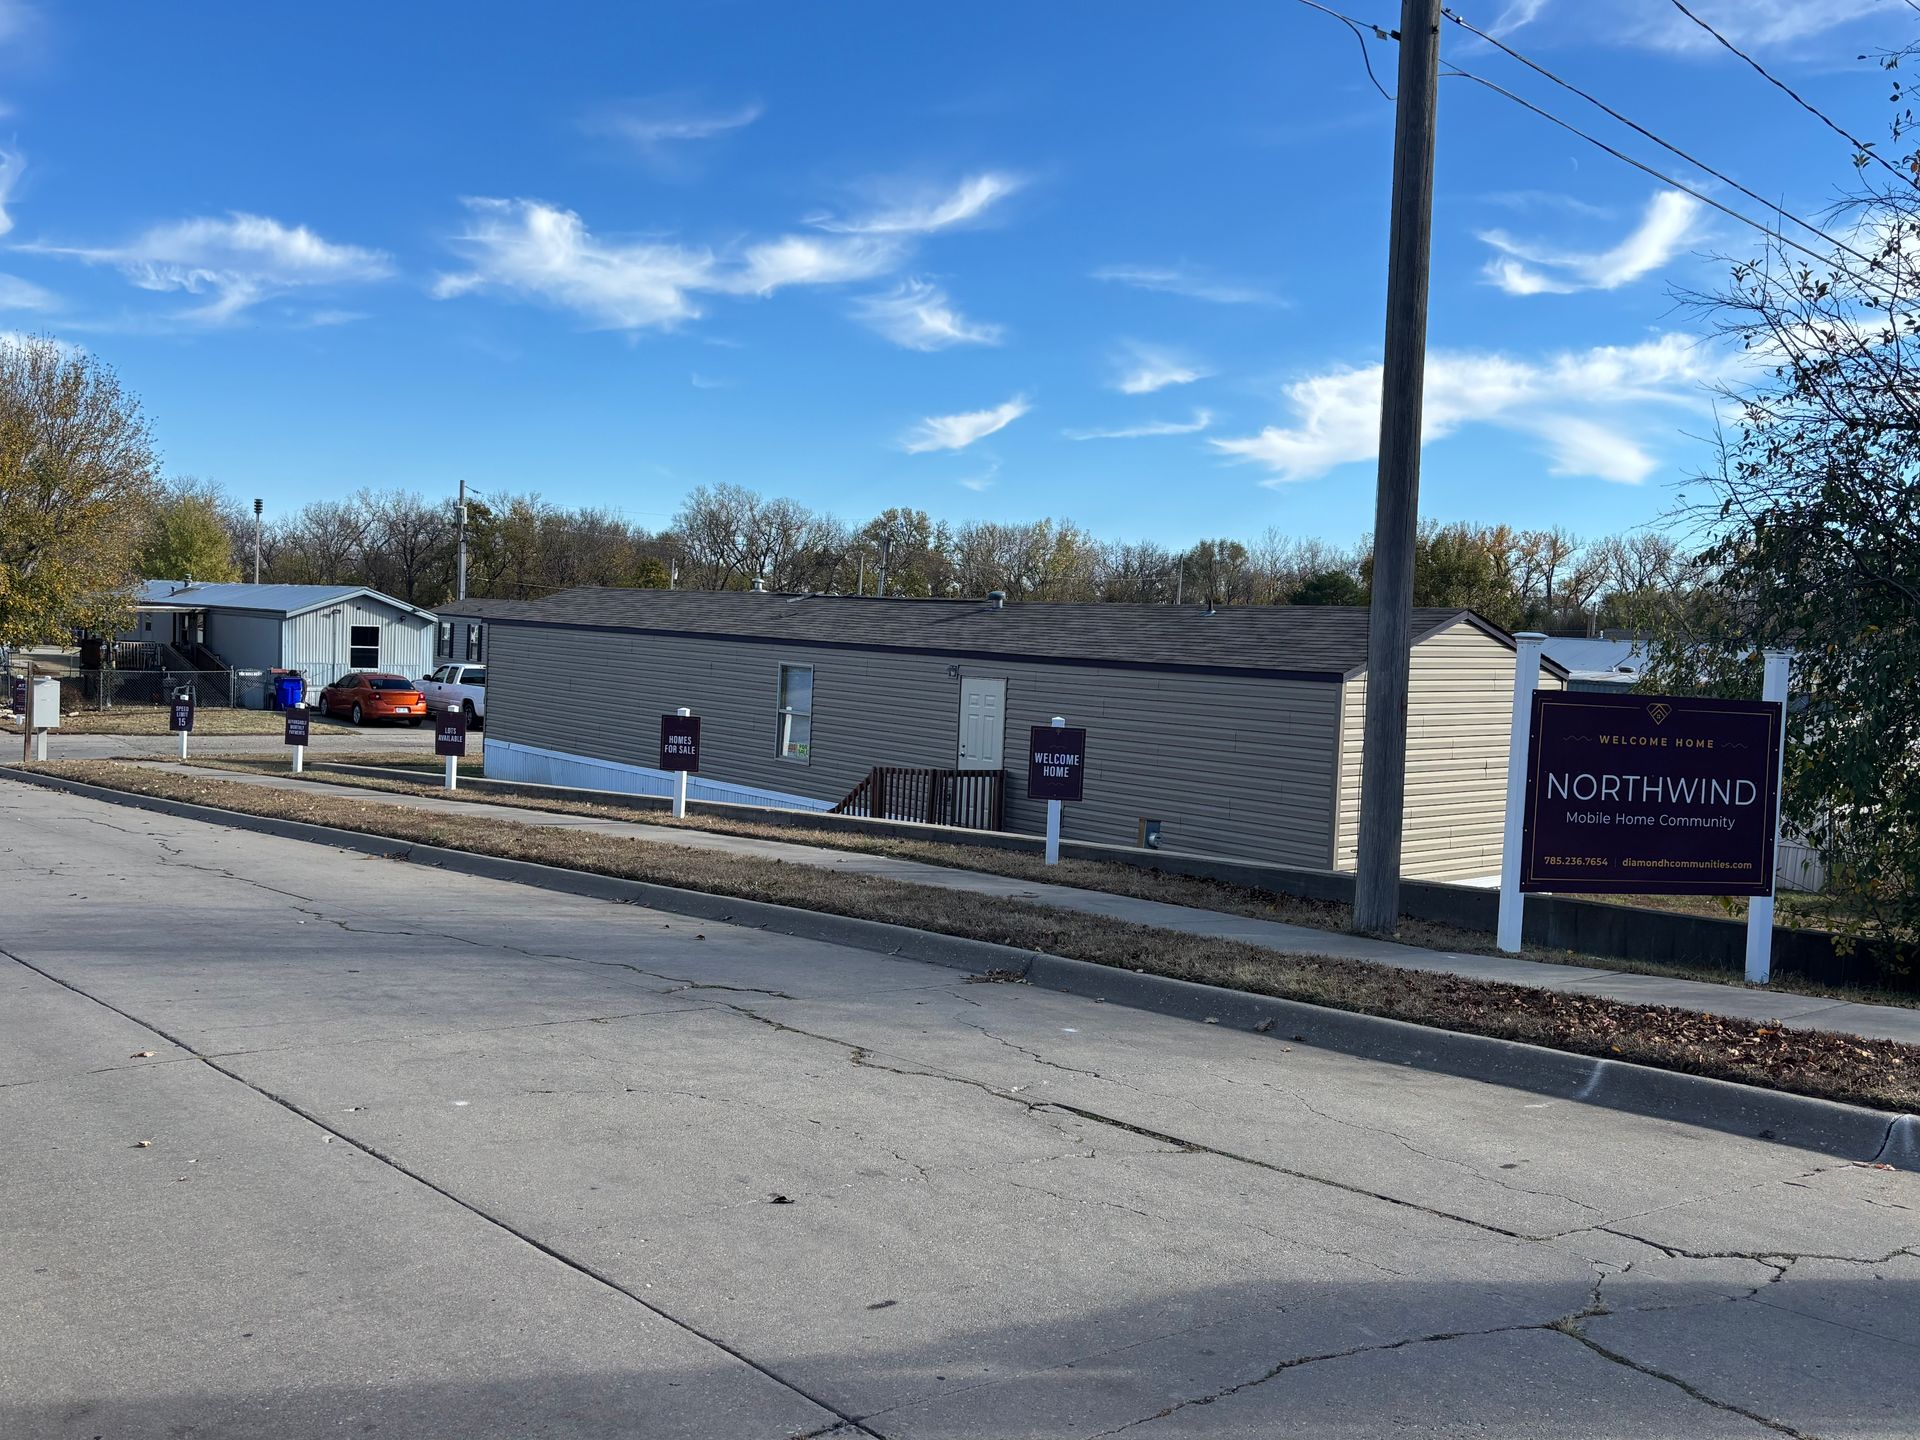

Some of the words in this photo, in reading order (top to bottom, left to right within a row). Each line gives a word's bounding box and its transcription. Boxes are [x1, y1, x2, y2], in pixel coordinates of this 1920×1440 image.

[178, 717, 186, 726] 15
[444, 727, 457, 735] LOTS
[438, 734, 463, 743] AVAILABLE
[668, 735, 692, 745] HOMES
[1599, 734, 1668, 747] WELCOME
[1675, 737, 1715, 749] HOME
[664, 744, 678, 754] FOR
[678, 745, 696, 755] SALE
[1034, 752, 1080, 765] WELCOME
[1043, 765, 1070, 778] HOME
[1546, 772, 1757, 807] NORTHWIND
[1566, 811, 1611, 825] Mobile
[1615, 812, 1655, 826] Home
[1659, 813, 1736, 831] Community
[1544, 856, 1609, 867] 785.236.7654
[1622, 857, 1753, 870] diamondhcommunities.com
